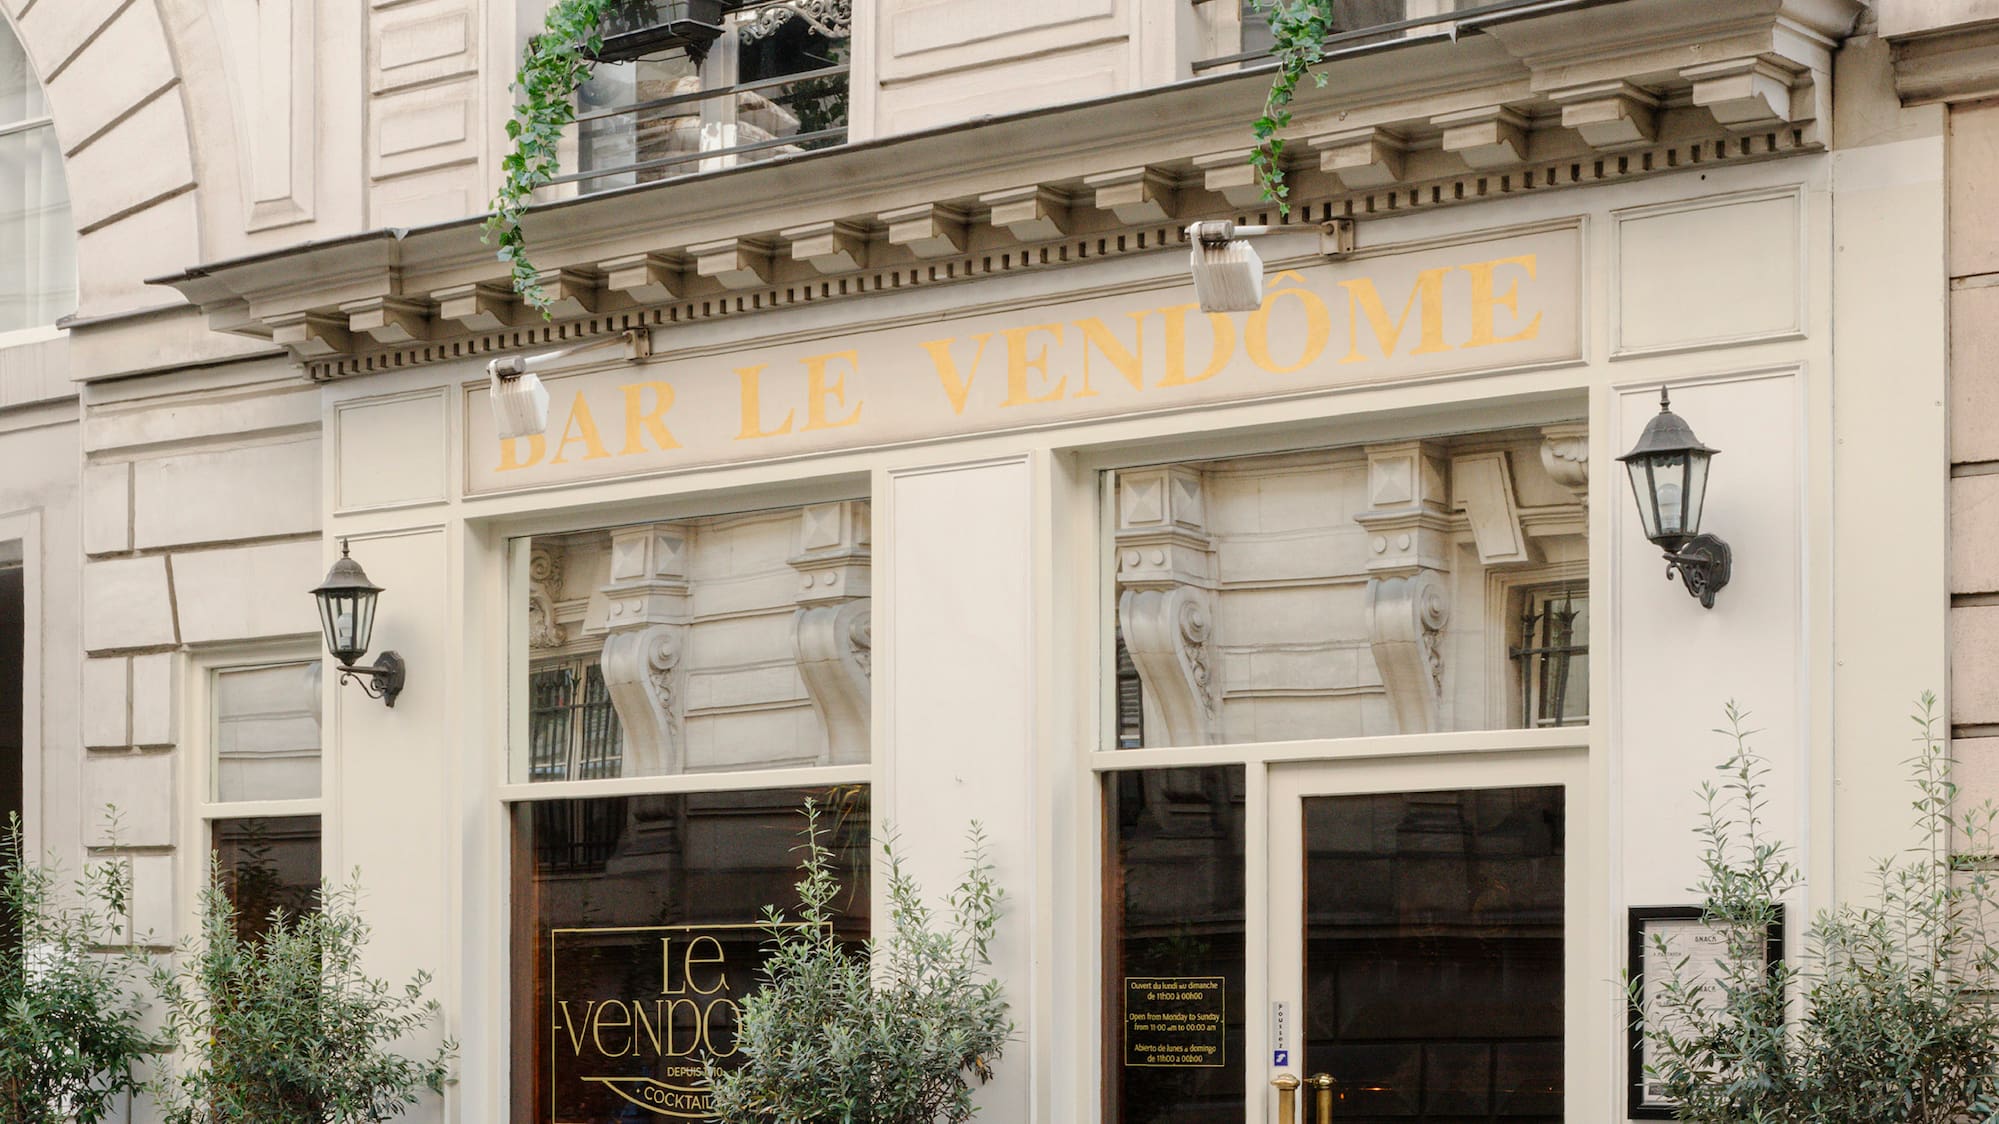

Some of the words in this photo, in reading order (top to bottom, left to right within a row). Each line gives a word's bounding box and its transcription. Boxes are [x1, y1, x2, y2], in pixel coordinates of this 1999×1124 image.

[733, 349, 864, 441] LE
[918, 253, 1543, 417] VENDÔME
[1130, 981, 1152, 990] Ouvert
[1153, 982, 1162, 990] du
[1188, 981, 1219, 989] dimanche
[1147, 992, 1156, 1000] de
[1156, 992, 1176, 1000] 11h00
[1181, 992, 1204, 1000] 00h00
[1129, 1013, 1146, 1022] Open
[1163, 1013, 1188, 1022] Monday
[1197, 1013, 1220, 1022] Sunday
[1134, 1044, 1157, 1052] Abierto
[1158, 1044, 1167, 1052] de
[1167, 1044, 1184, 1052] lunes
[1189, 1044, 1217, 1054] domingo
[667, 1066, 702, 1077] DEPUIS
[703, 1066, 724, 1077] 110
